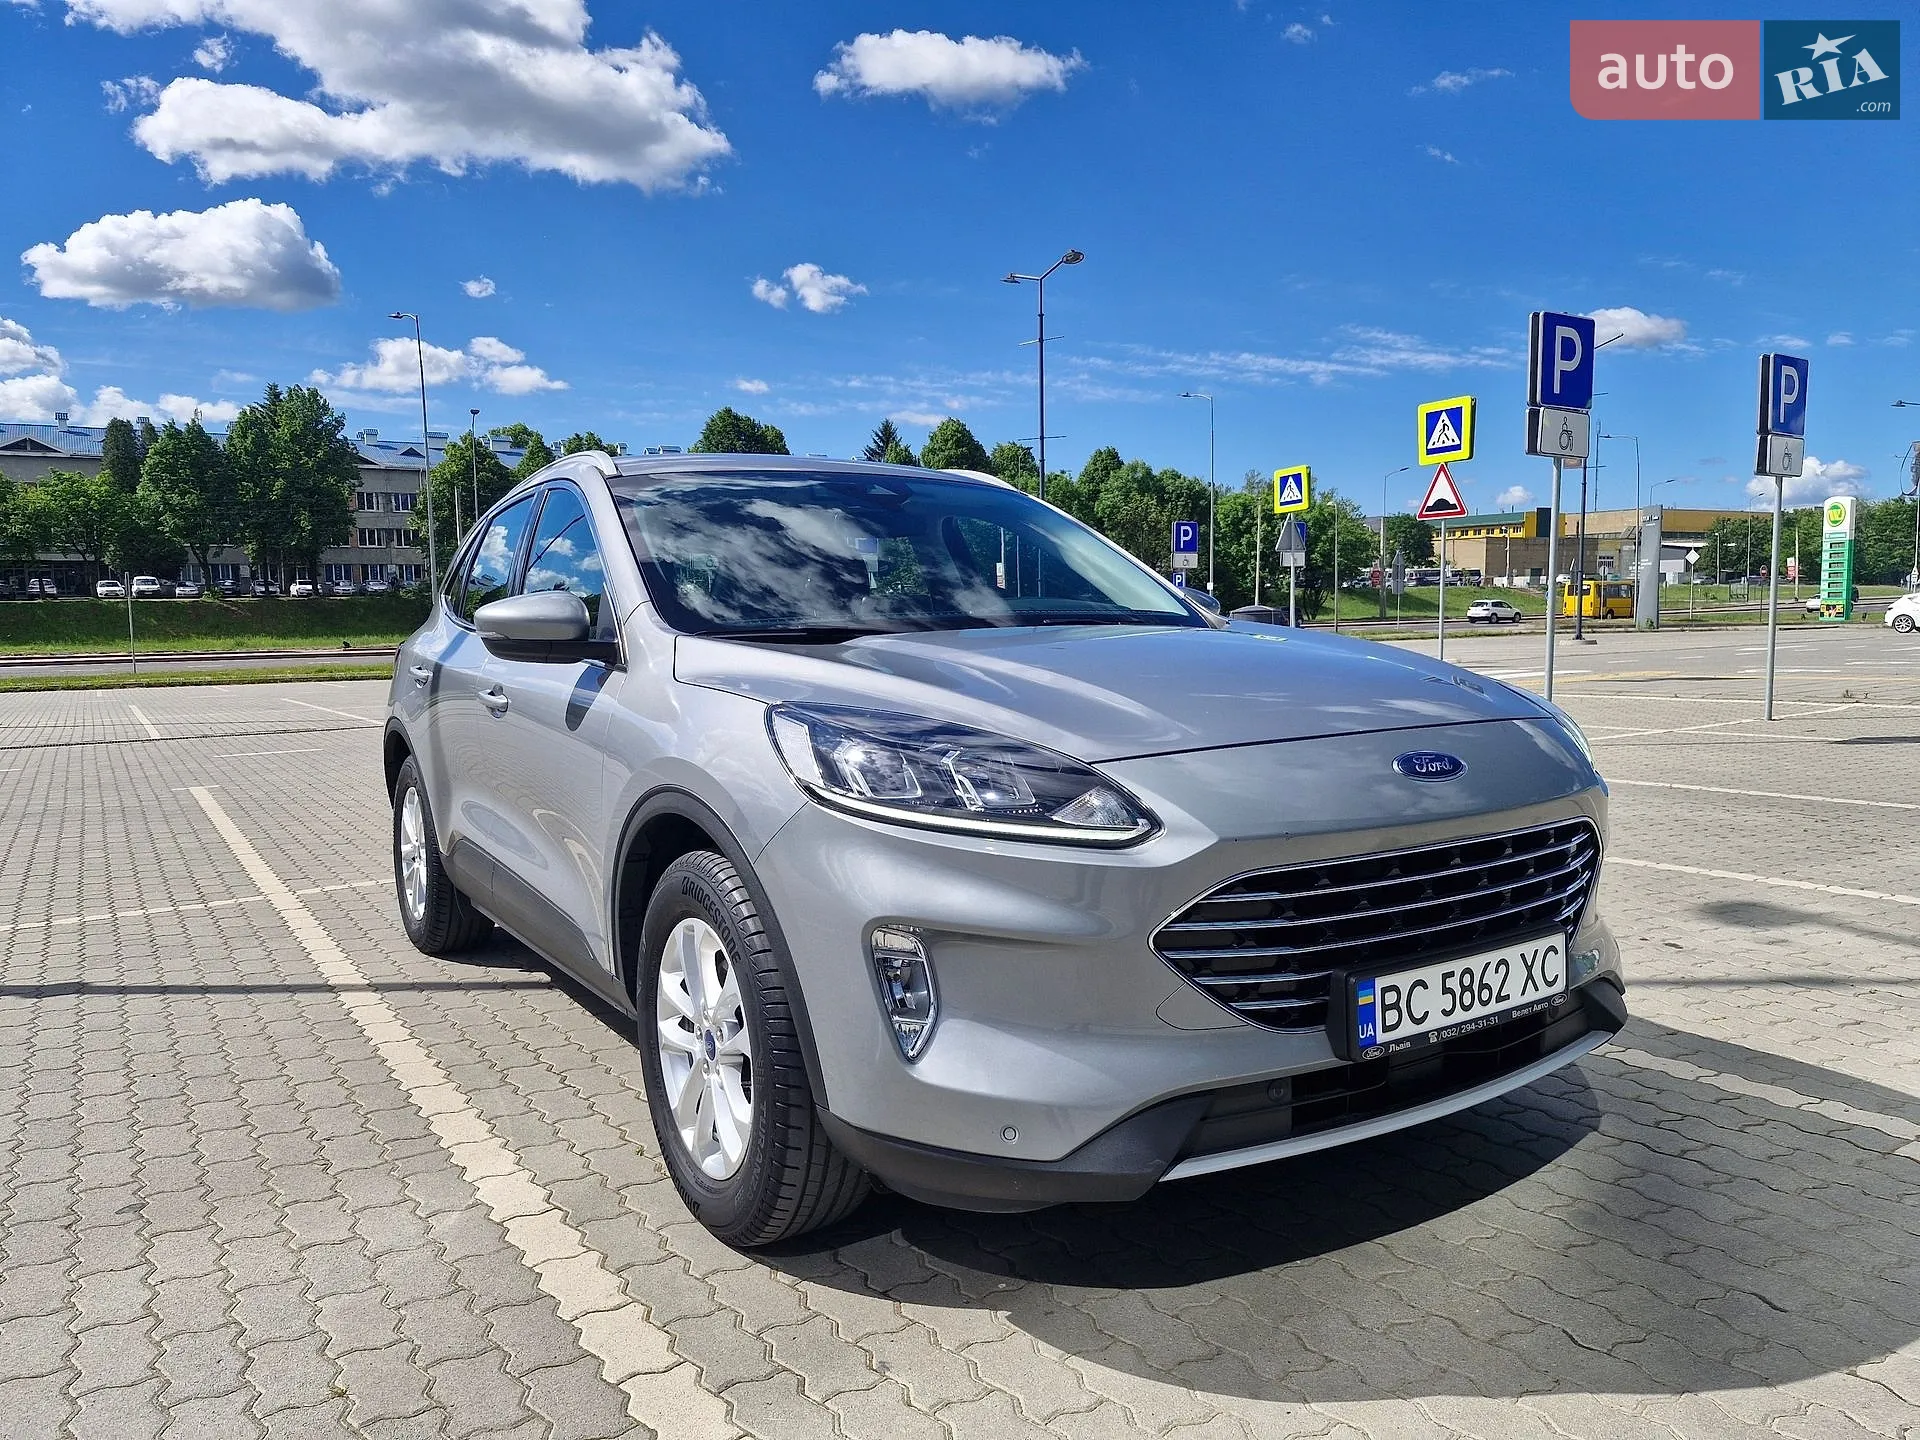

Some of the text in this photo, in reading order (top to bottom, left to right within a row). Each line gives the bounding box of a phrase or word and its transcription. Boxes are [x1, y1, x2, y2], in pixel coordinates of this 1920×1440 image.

[1553, 325, 1582, 394] P
[1780, 365, 1799, 423] P
[1180, 525, 1193, 549] P
[1175, 574, 1182, 586] P
[1412, 755, 1453, 773] Ford
[681, 876, 741, 965] BRIDGESTONE
[1380, 944, 1560, 1034] BC 5862 XC
[1358, 1022, 1375, 1039] UA
[1461, 1015, 1499, 1033] 294-31-31
[1388, 1040, 1411, 1053] Львів
